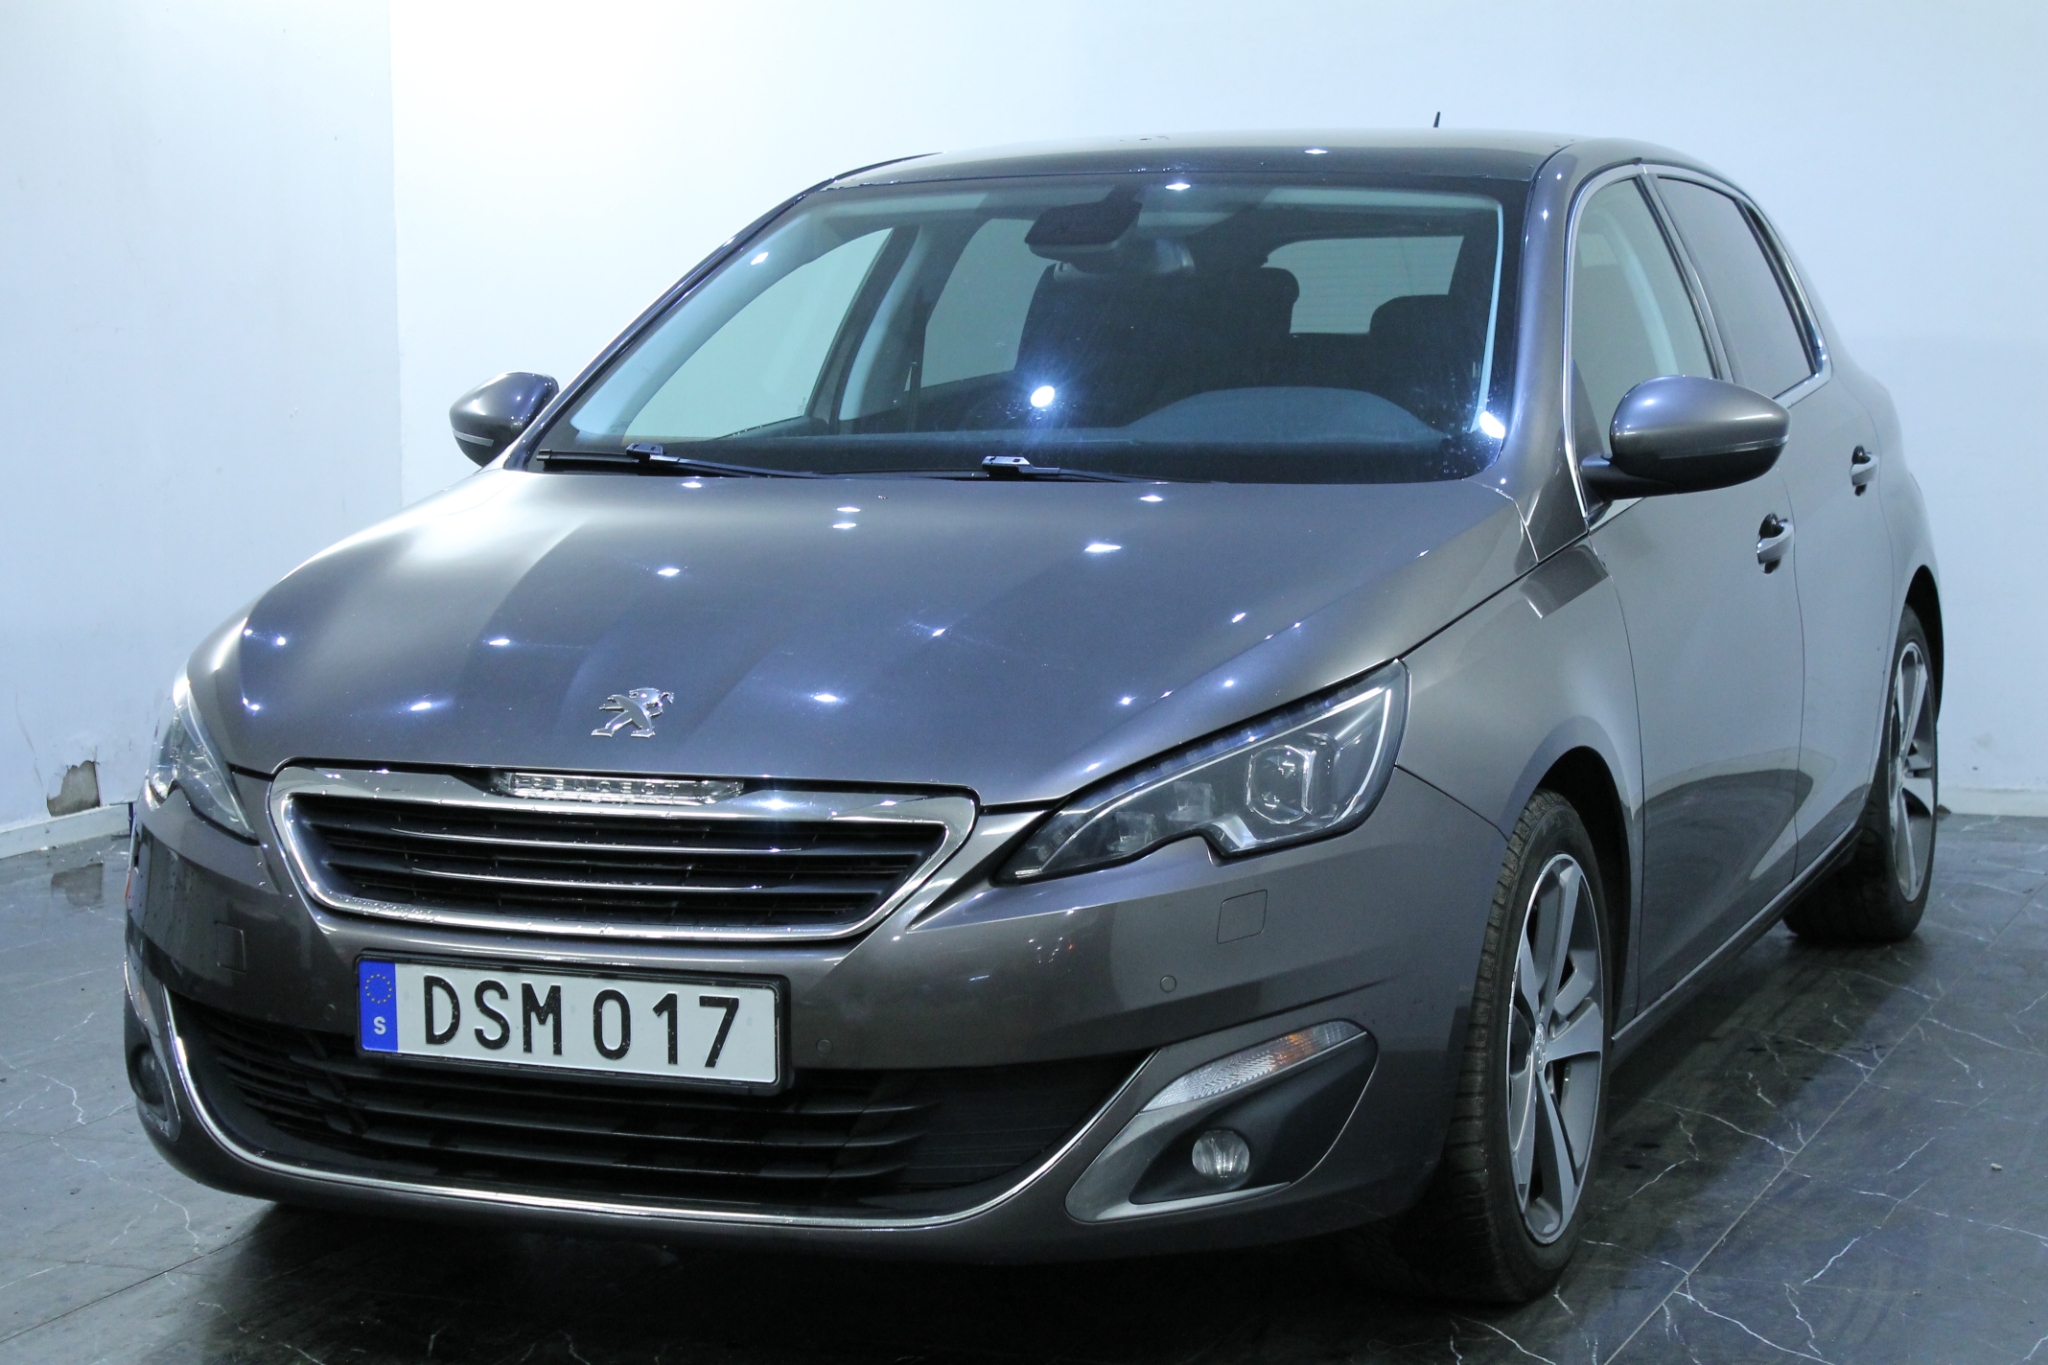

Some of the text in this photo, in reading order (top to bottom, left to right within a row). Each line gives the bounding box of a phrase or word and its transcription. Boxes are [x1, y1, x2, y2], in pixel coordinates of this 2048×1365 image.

[373, 1016, 387, 1035] S
[423, 975, 740, 1069] DSM 017
